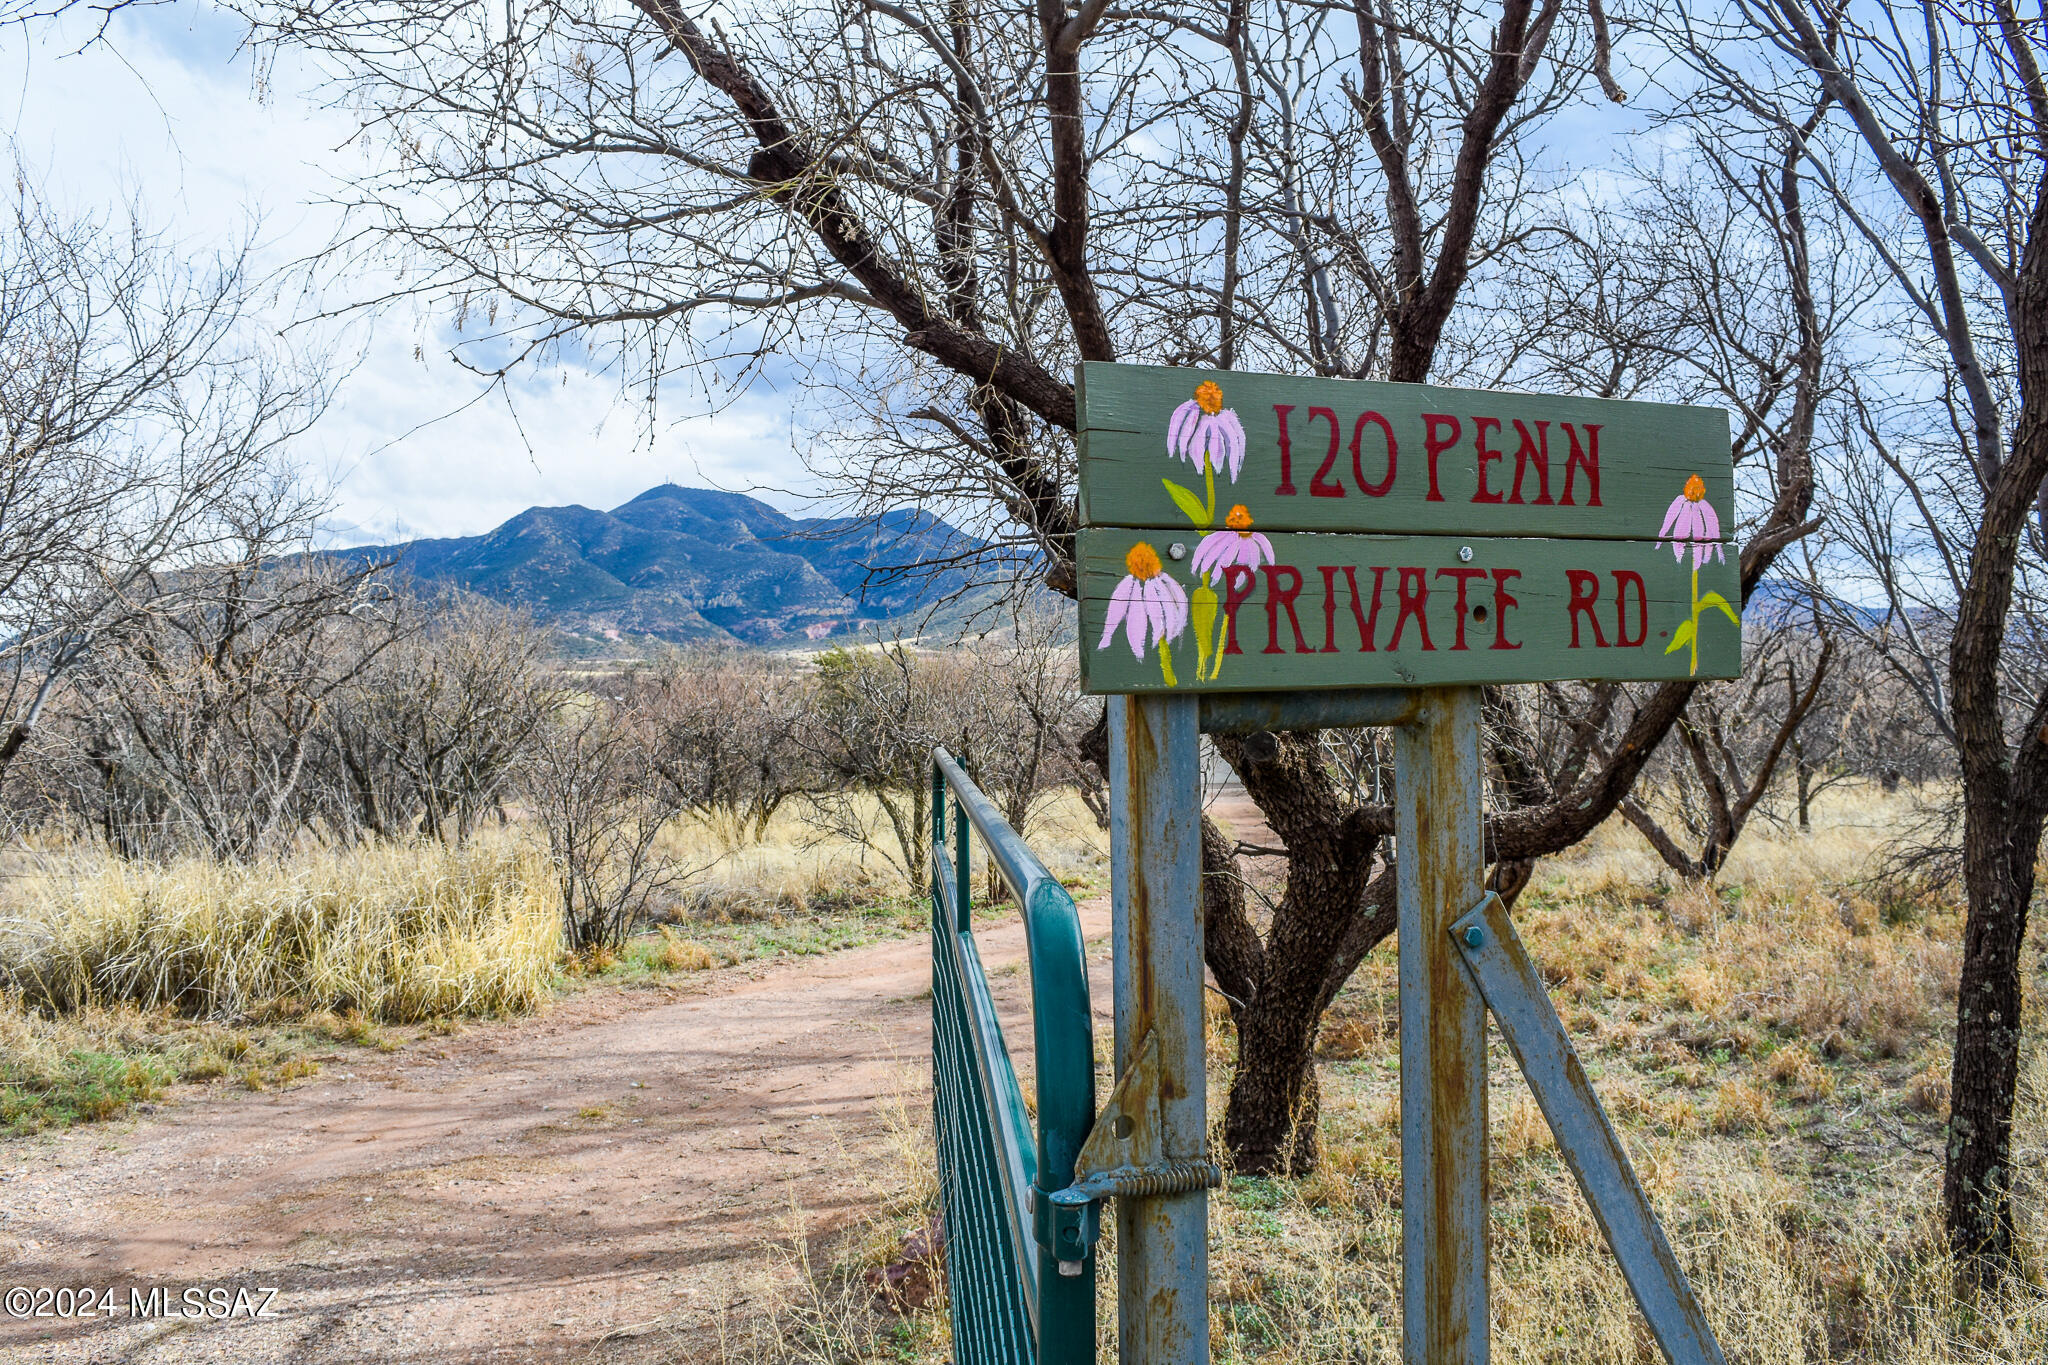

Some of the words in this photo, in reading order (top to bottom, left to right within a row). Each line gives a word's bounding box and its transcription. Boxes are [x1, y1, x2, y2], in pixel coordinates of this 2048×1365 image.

[1273, 404, 1397, 498] 120
[1421, 413, 1604, 507] PENN
[1223, 565, 1524, 655] PRIVATE
